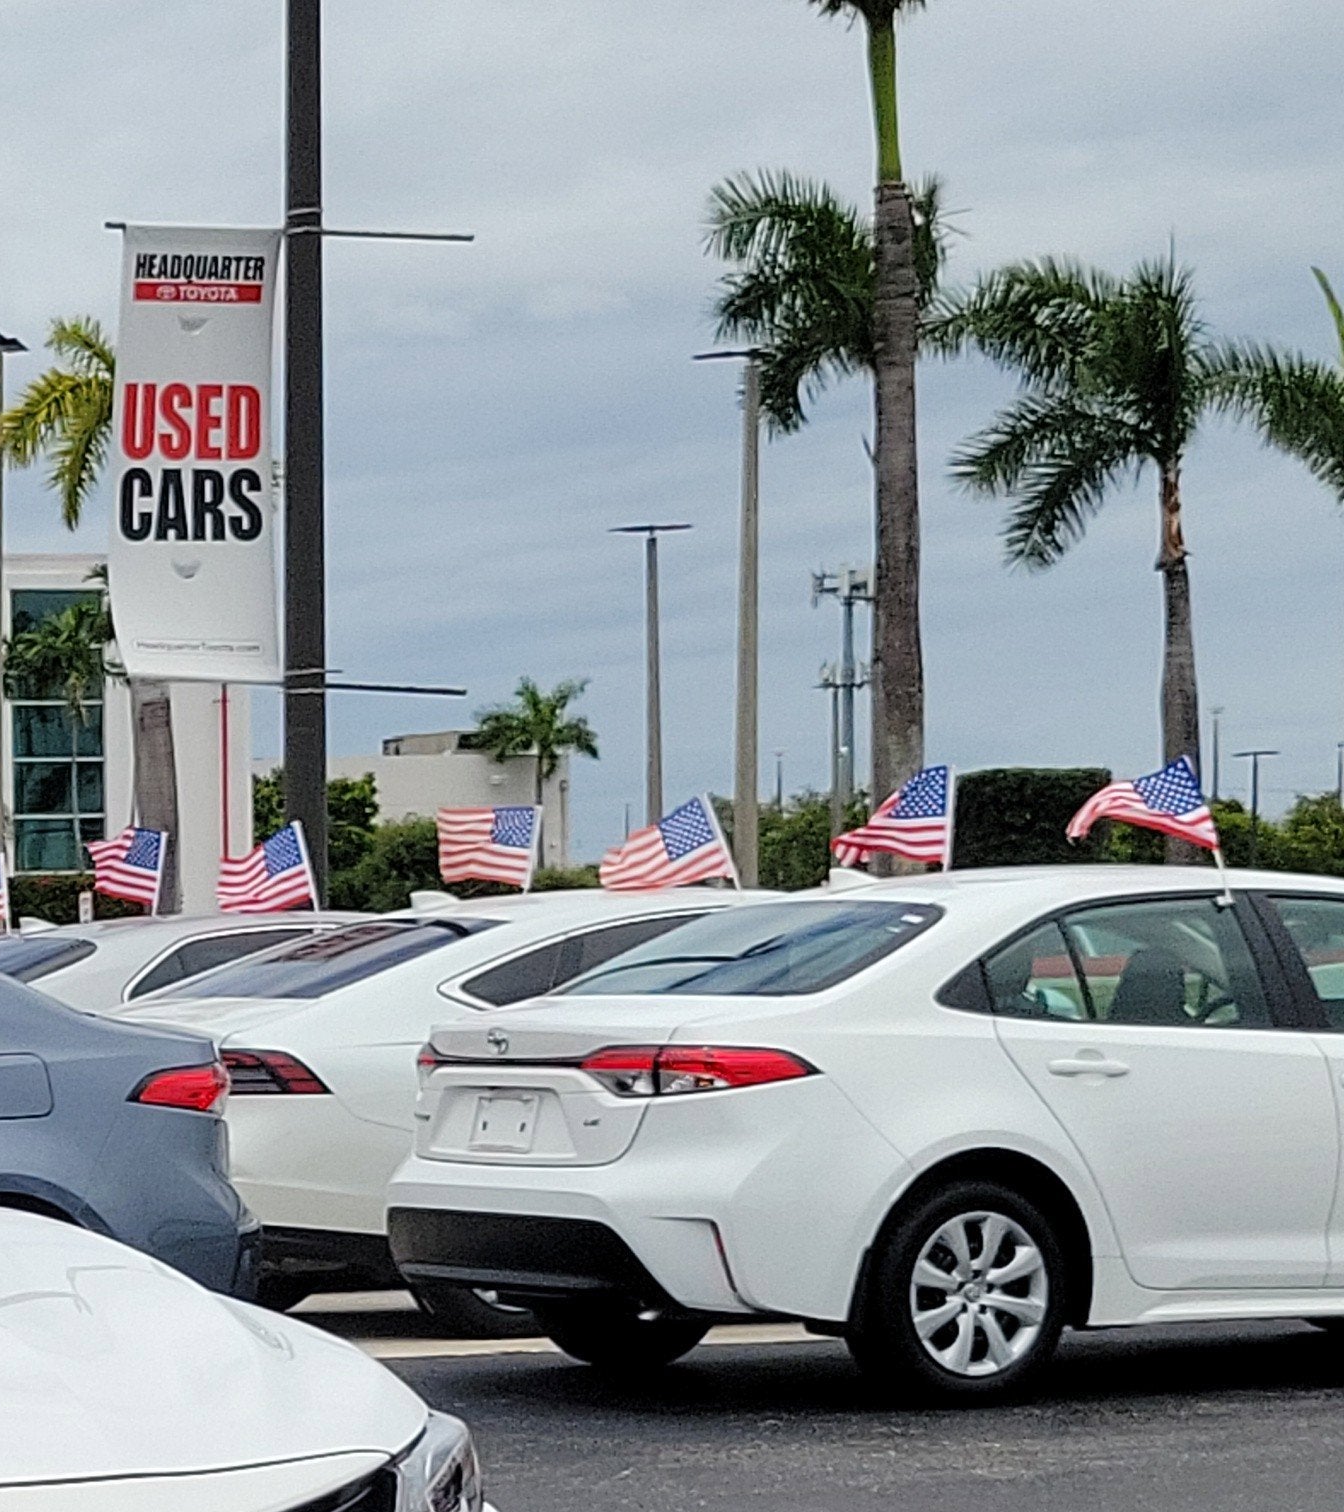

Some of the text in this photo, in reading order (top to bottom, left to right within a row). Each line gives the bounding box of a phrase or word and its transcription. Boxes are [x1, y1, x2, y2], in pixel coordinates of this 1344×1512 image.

[135, 253, 264, 284] HEADQUARTER
[179, 286, 238, 301] TOYOTA
[122, 383, 261, 460] USED
[119, 467, 263, 542] CARS
